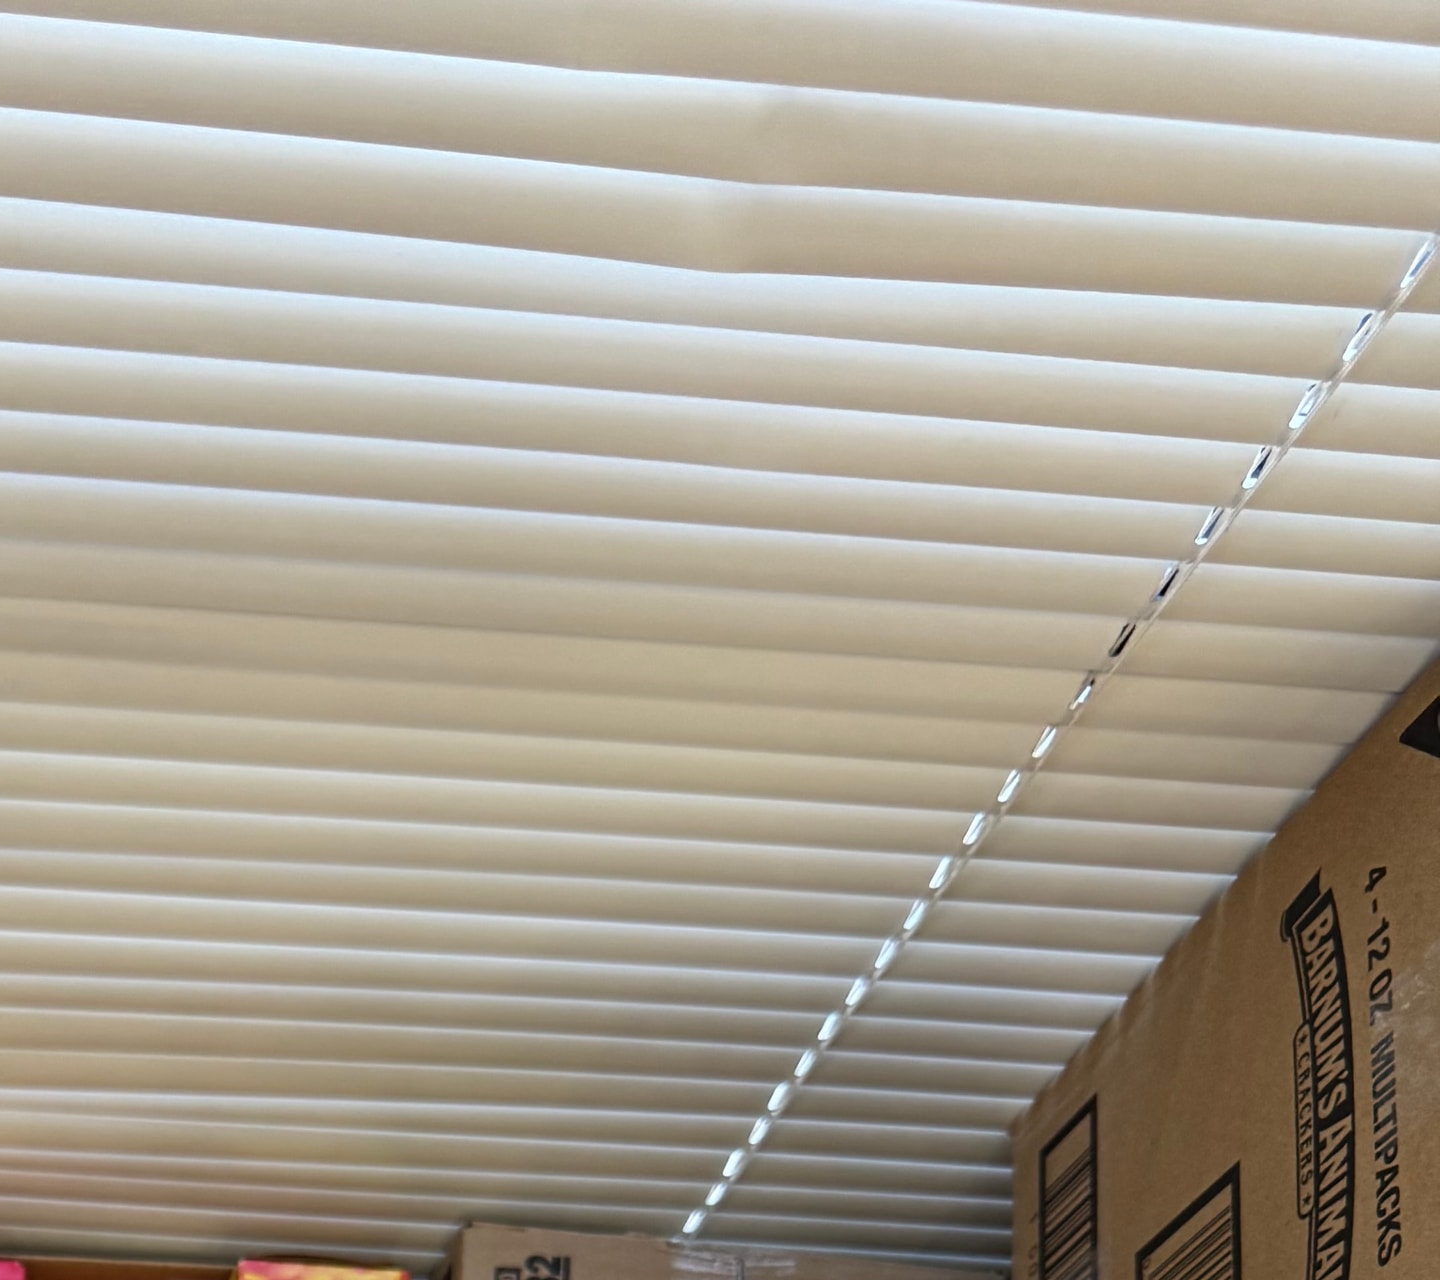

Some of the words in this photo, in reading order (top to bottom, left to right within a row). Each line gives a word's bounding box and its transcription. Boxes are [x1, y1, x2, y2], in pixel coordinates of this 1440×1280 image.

[1299, 902, 1348, 1120] BARNUM'S
[1366, 917, 1390, 972] 12
[1368, 969, 1392, 1026] OZ
[1297, 1050, 1313, 1186] CRACKERS
[1370, 1031, 1402, 1267] MULTIPACKS
